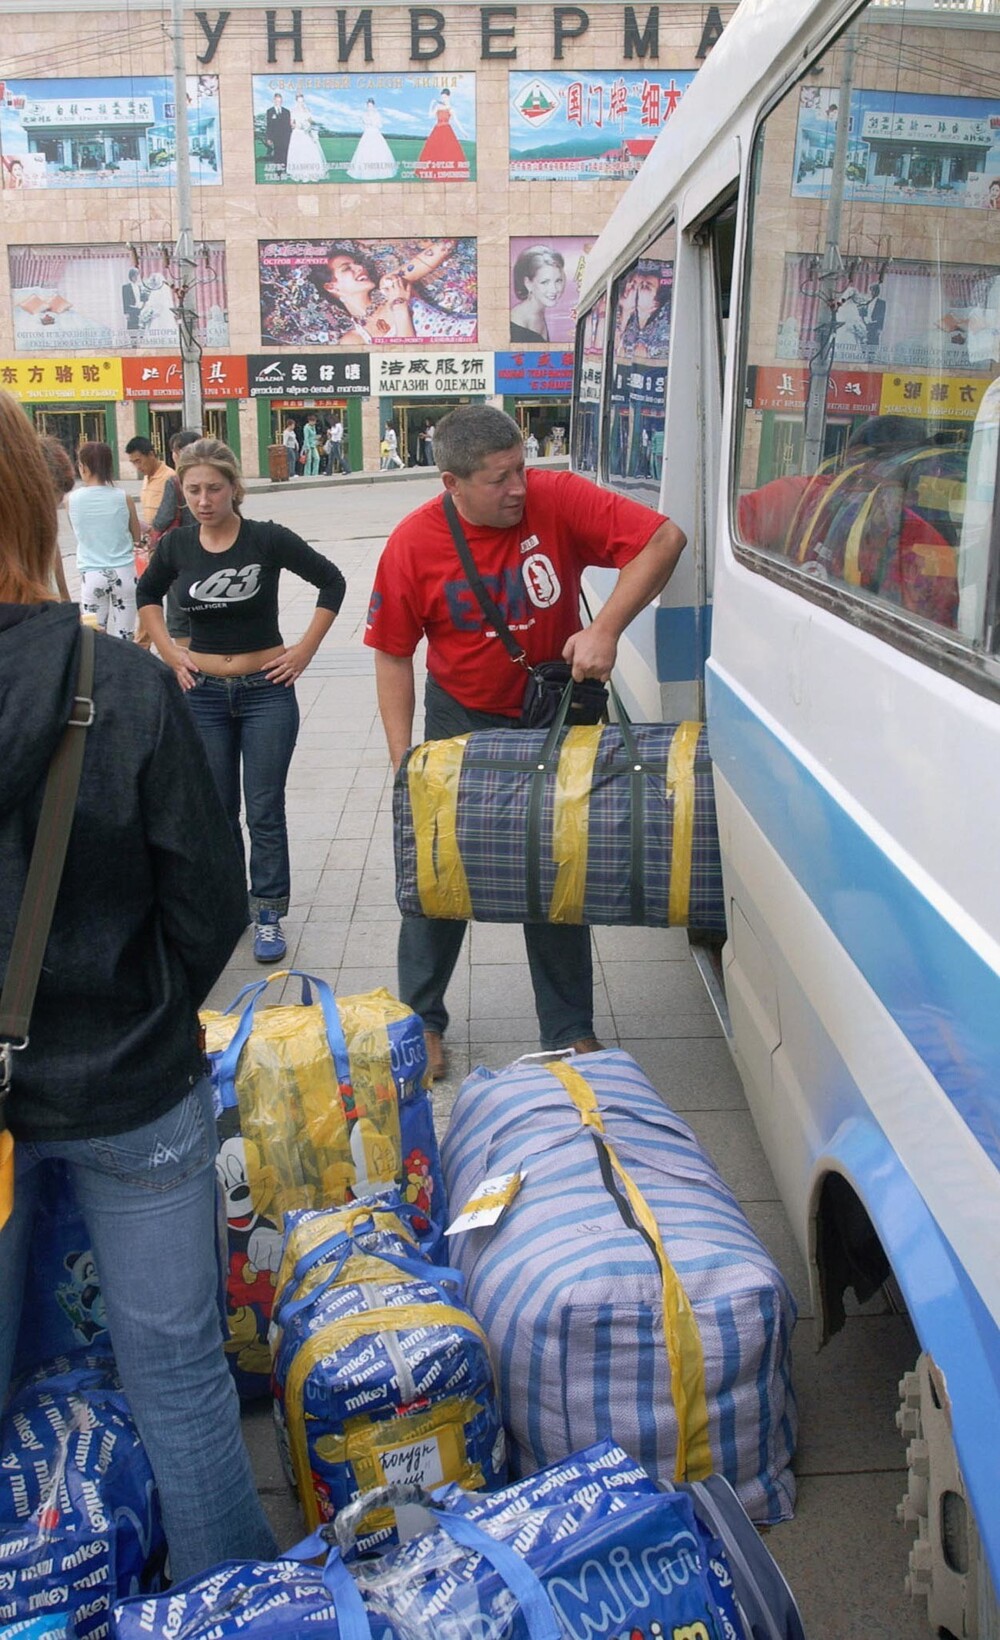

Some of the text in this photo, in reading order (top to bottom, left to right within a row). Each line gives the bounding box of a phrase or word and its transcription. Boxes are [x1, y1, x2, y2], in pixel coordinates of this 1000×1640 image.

[379, 378, 487, 392] МАГАЗИН ОДЕЖДЫ
[194, 563, 262, 599] 63
[336, 1344, 376, 1378] mikey
[344, 1382, 388, 1412] mikey
[81, 1481, 109, 1534] mikey
[61, 1539, 110, 1572] mikey
[356, 1526, 393, 1552] mimi
